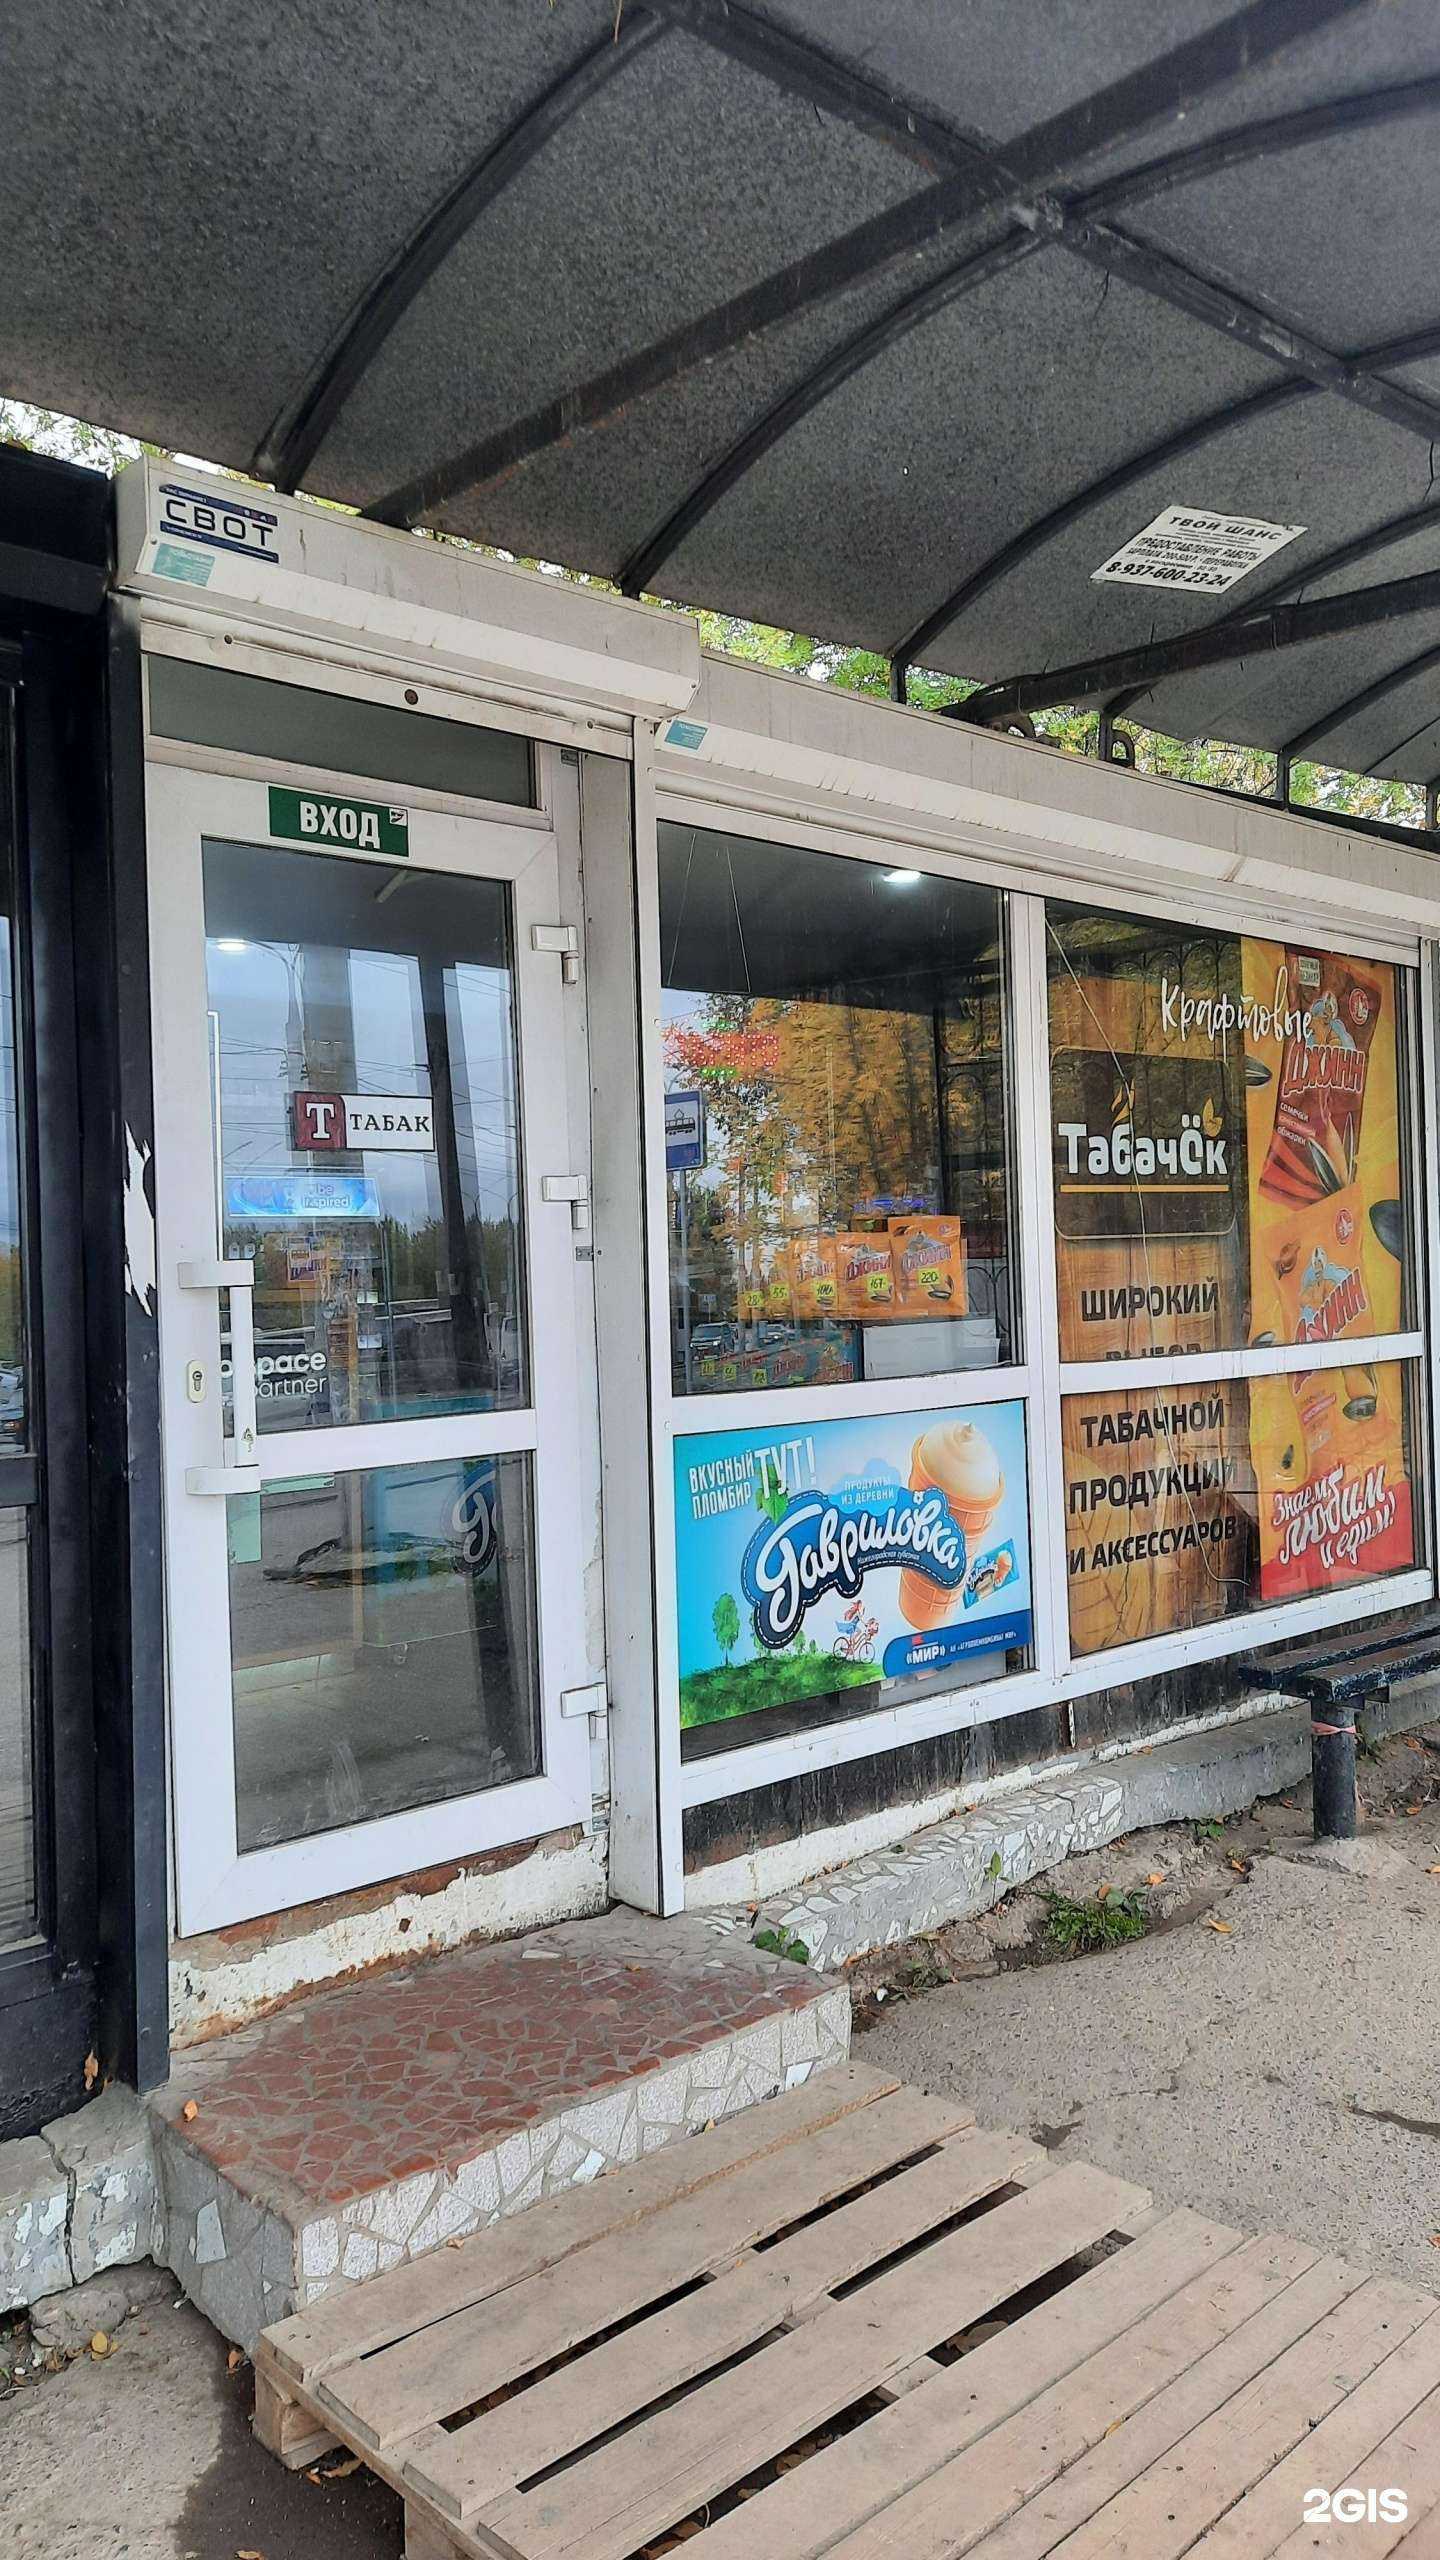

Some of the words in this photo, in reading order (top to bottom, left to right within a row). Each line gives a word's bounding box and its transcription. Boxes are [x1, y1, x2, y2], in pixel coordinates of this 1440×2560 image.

[166, 499, 274, 546] СВОТ
[1224, 524, 1282, 540] ШАНС
[1105, 561, 1233, 586] 8-937-600-23-24
[300, 800, 381, 849] ВХОД
[1161, 965, 1313, 1064] Крафтовые
[1282, 1039, 1366, 1098] ДЖИНН
[350, 1113, 431, 1132] ТАБАК
[1080, 1276, 1220, 1322] ШИРОКИЙ
[253, 1352, 327, 1381] pace
[1080, 1392, 1225, 1448] ТАБАЧНОЙ
[689, 1449, 755, 1493] ВКУСНЫЙ
[755, 1436, 817, 1499] ТУТ!
[844, 1476, 891, 1491] ПРОДУКТЫ
[1069, 1455, 1237, 1514] ПРОДУКЦИИ
[692, 1481, 752, 1519] ПЛОМБИР
[841, 1493, 853, 1505] ИЗ
[854, 1487, 895, 1504] ДЕРЕВНИ
[1272, 1476, 1329, 1527] Знаем
[755, 1498, 960, 1633] Гавриловка
[1069, 1547, 1086, 1575] И
[1091, 1515, 1237, 1570] АКСЕССУАРОВ
[906, 1645, 946, 1665] «МИР»
